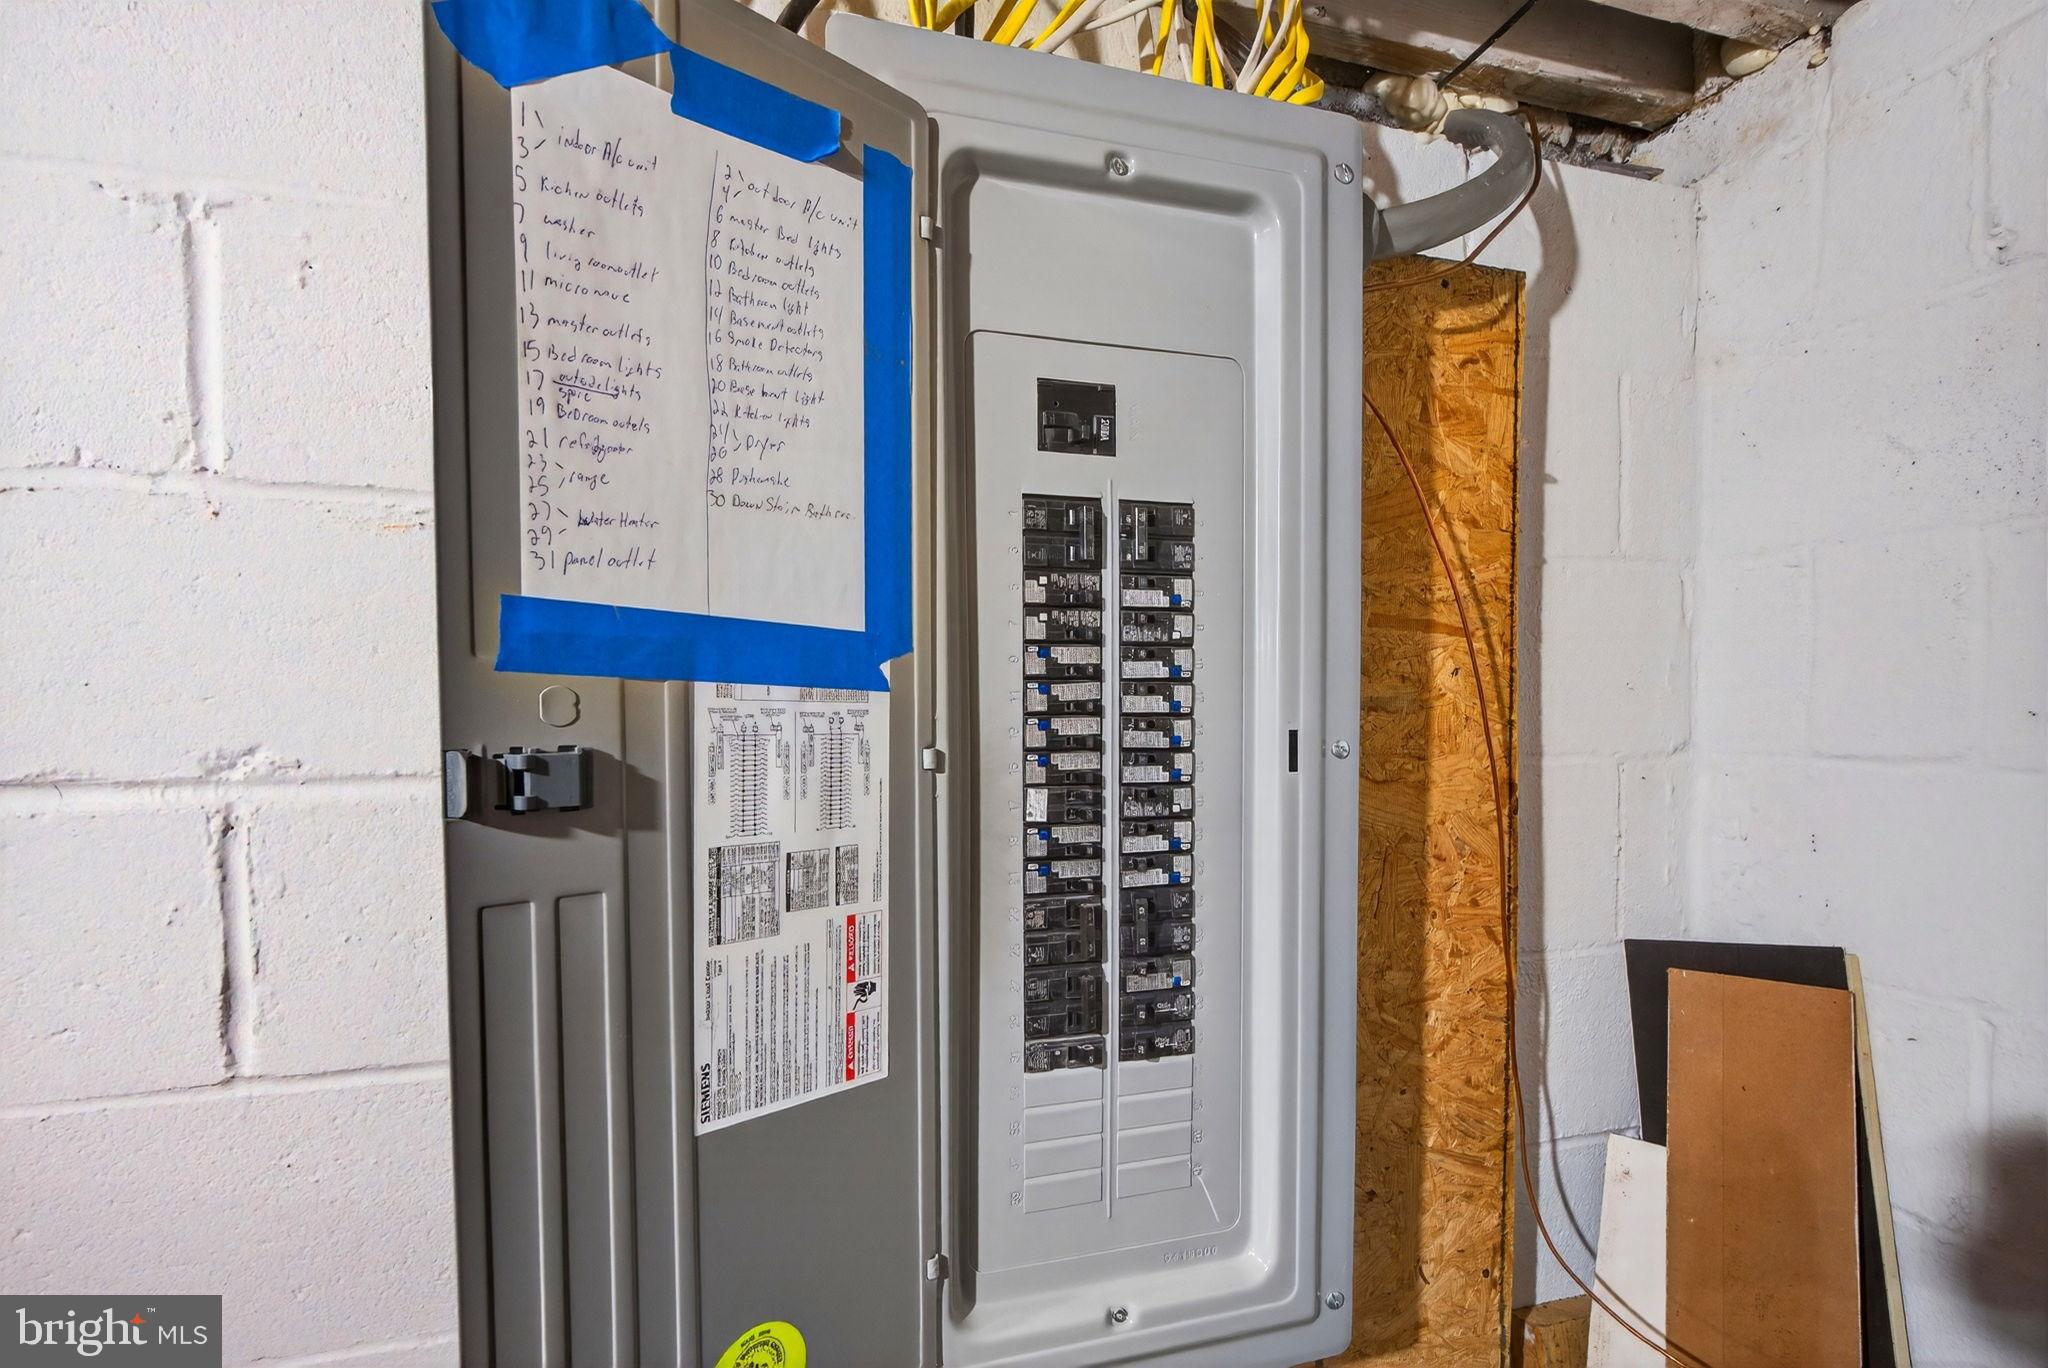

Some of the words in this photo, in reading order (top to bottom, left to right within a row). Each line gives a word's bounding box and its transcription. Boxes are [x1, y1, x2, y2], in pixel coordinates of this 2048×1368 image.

[516, 136, 529, 158] 3
[628, 155, 657, 171] unit
[724, 164, 731, 180] 2
[515, 165, 527, 192] 5
[596, 189, 644, 217] outlets
[716, 204, 724, 224] 6
[722, 184, 731, 203] 4
[830, 213, 858, 232] unit
[520, 233, 528, 263] 9
[711, 229, 721, 248] 8
[775, 254, 815, 278] outlets
[521, 269, 534, 292] 11
[709, 254, 722, 270] 10
[781, 278, 820, 301] outlets
[709, 279, 722, 297] 12
[520, 302, 539, 329] 13
[547, 313, 600, 335] master
[709, 305, 724, 324] 14
[787, 322, 824, 341] outlets
[708, 329, 722, 345] 16
[727, 330, 763, 350] Smoke
[523, 339, 541, 362] 15
[548, 344, 612, 369] Bedroom
[618, 355, 664, 380] lights
[710, 354, 724, 373] 18
[526, 369, 544, 391] 17
[711, 378, 726, 394] 20
[529, 396, 546, 416] 19
[713, 399, 729, 417] 22
[526, 427, 549, 449] 21
[527, 453, 548, 472] 23
[528, 475, 550, 497] 25
[569, 471, 610, 490] range
[710, 466, 723, 485] 28
[708, 489, 726, 507] 30
[527, 500, 551, 520] 27
[526, 525, 552, 546] 29
[530, 549, 555, 571] 31
[563, 547, 603, 575] panel
[607, 546, 656, 570] outlet
[700, 1062, 711, 1124] SIEMENS
